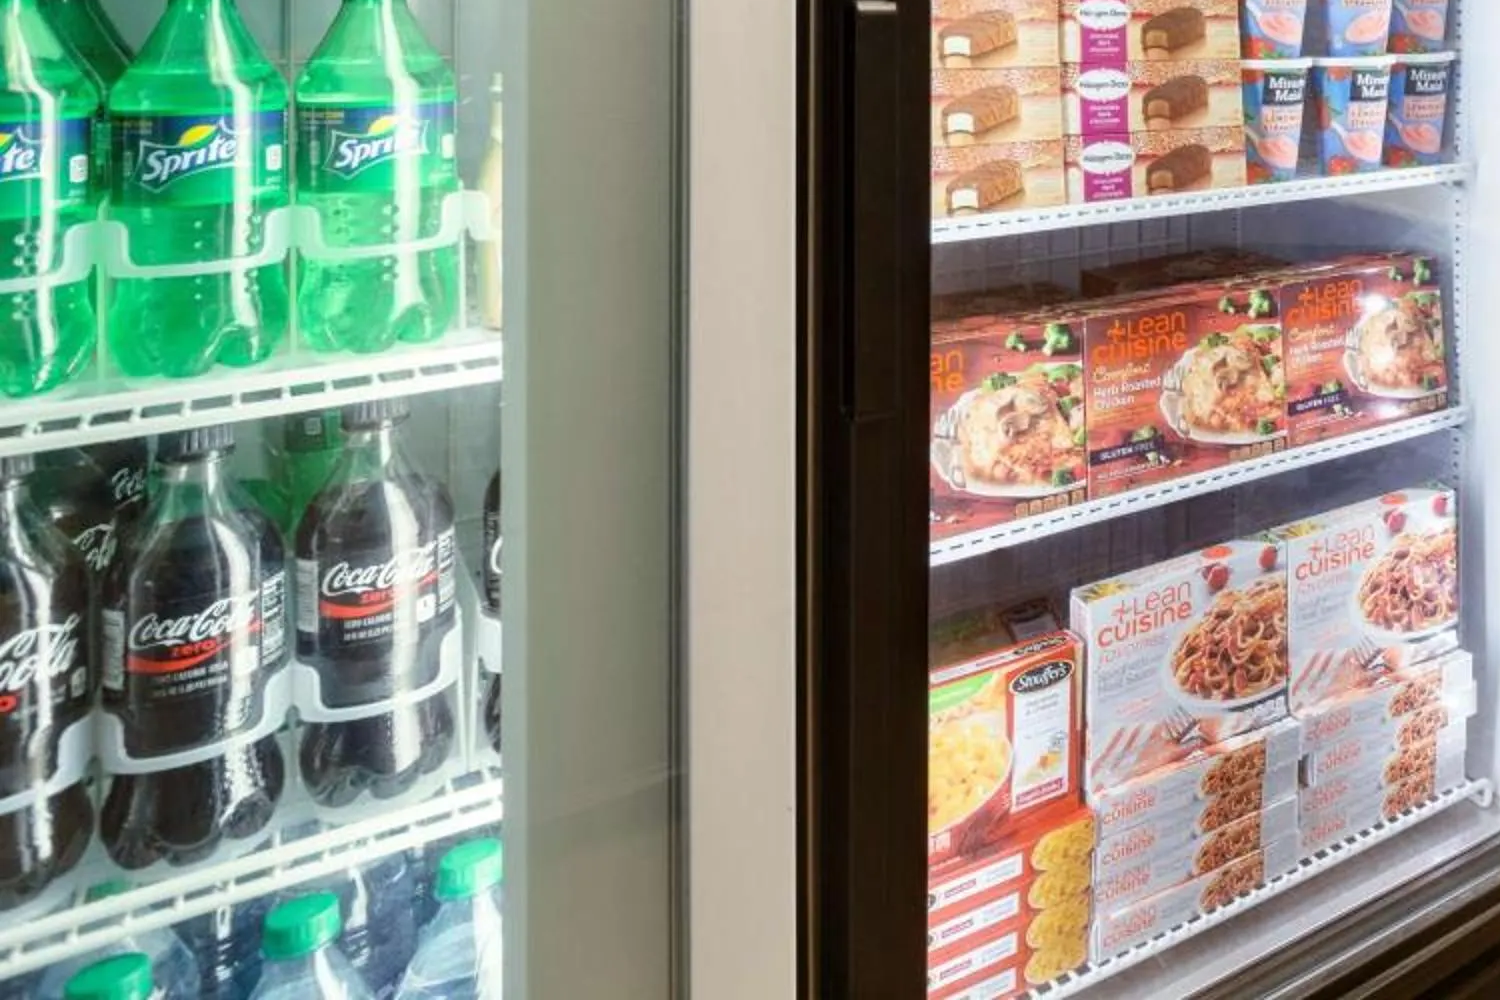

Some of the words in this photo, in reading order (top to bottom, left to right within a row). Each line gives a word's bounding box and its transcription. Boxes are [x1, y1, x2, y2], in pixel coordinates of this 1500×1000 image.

[141, 134, 237, 182] Sprite
[1127, 311, 1187, 337] Lean
[1295, 540, 1375, 581] cuisine
[1133, 580, 1192, 616] Lean
[1096, 600, 1193, 647] cuisine
